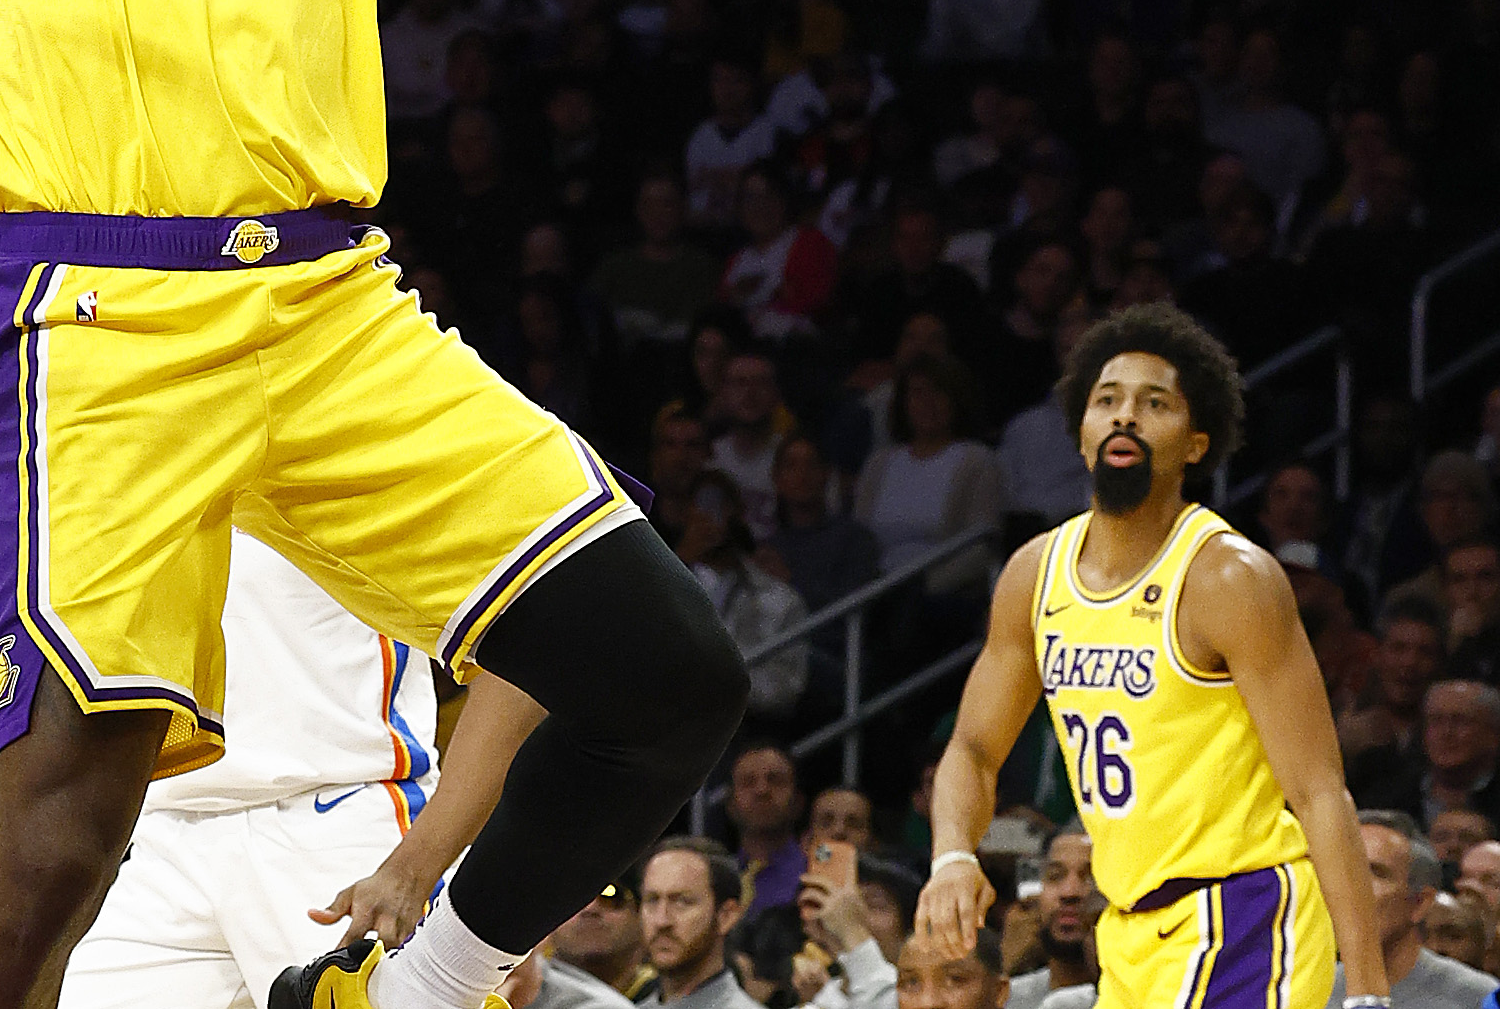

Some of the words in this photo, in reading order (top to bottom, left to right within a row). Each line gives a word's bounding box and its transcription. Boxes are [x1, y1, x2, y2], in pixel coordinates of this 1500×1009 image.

[225, 231, 278, 253] LAKERS
[1043, 633, 1156, 699] LAKERS
[1060, 711, 1135, 814] 26
